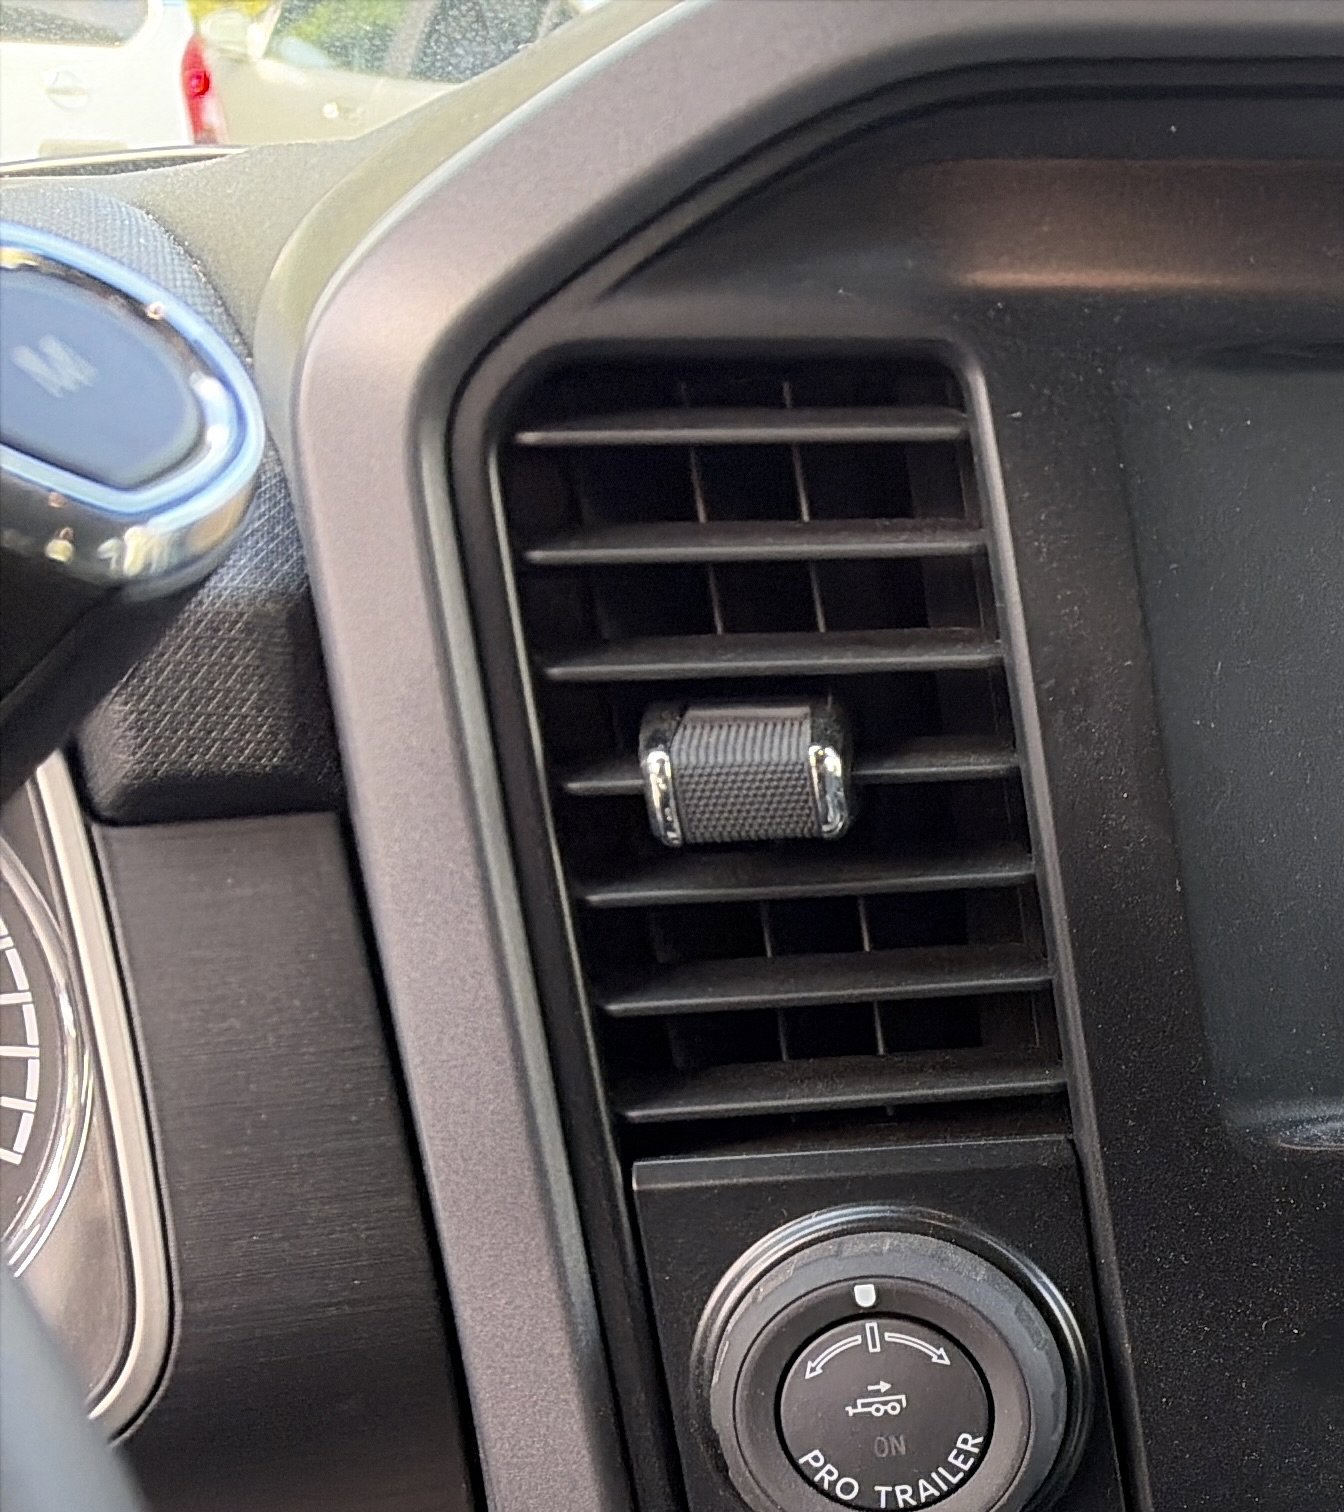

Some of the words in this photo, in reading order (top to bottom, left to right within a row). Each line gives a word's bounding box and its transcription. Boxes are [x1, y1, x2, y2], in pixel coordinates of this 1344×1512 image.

[798, 1447, 860, 1501] PRO
[873, 1430, 985, 1509] TRAILER
[873, 1433, 907, 1459] ON
